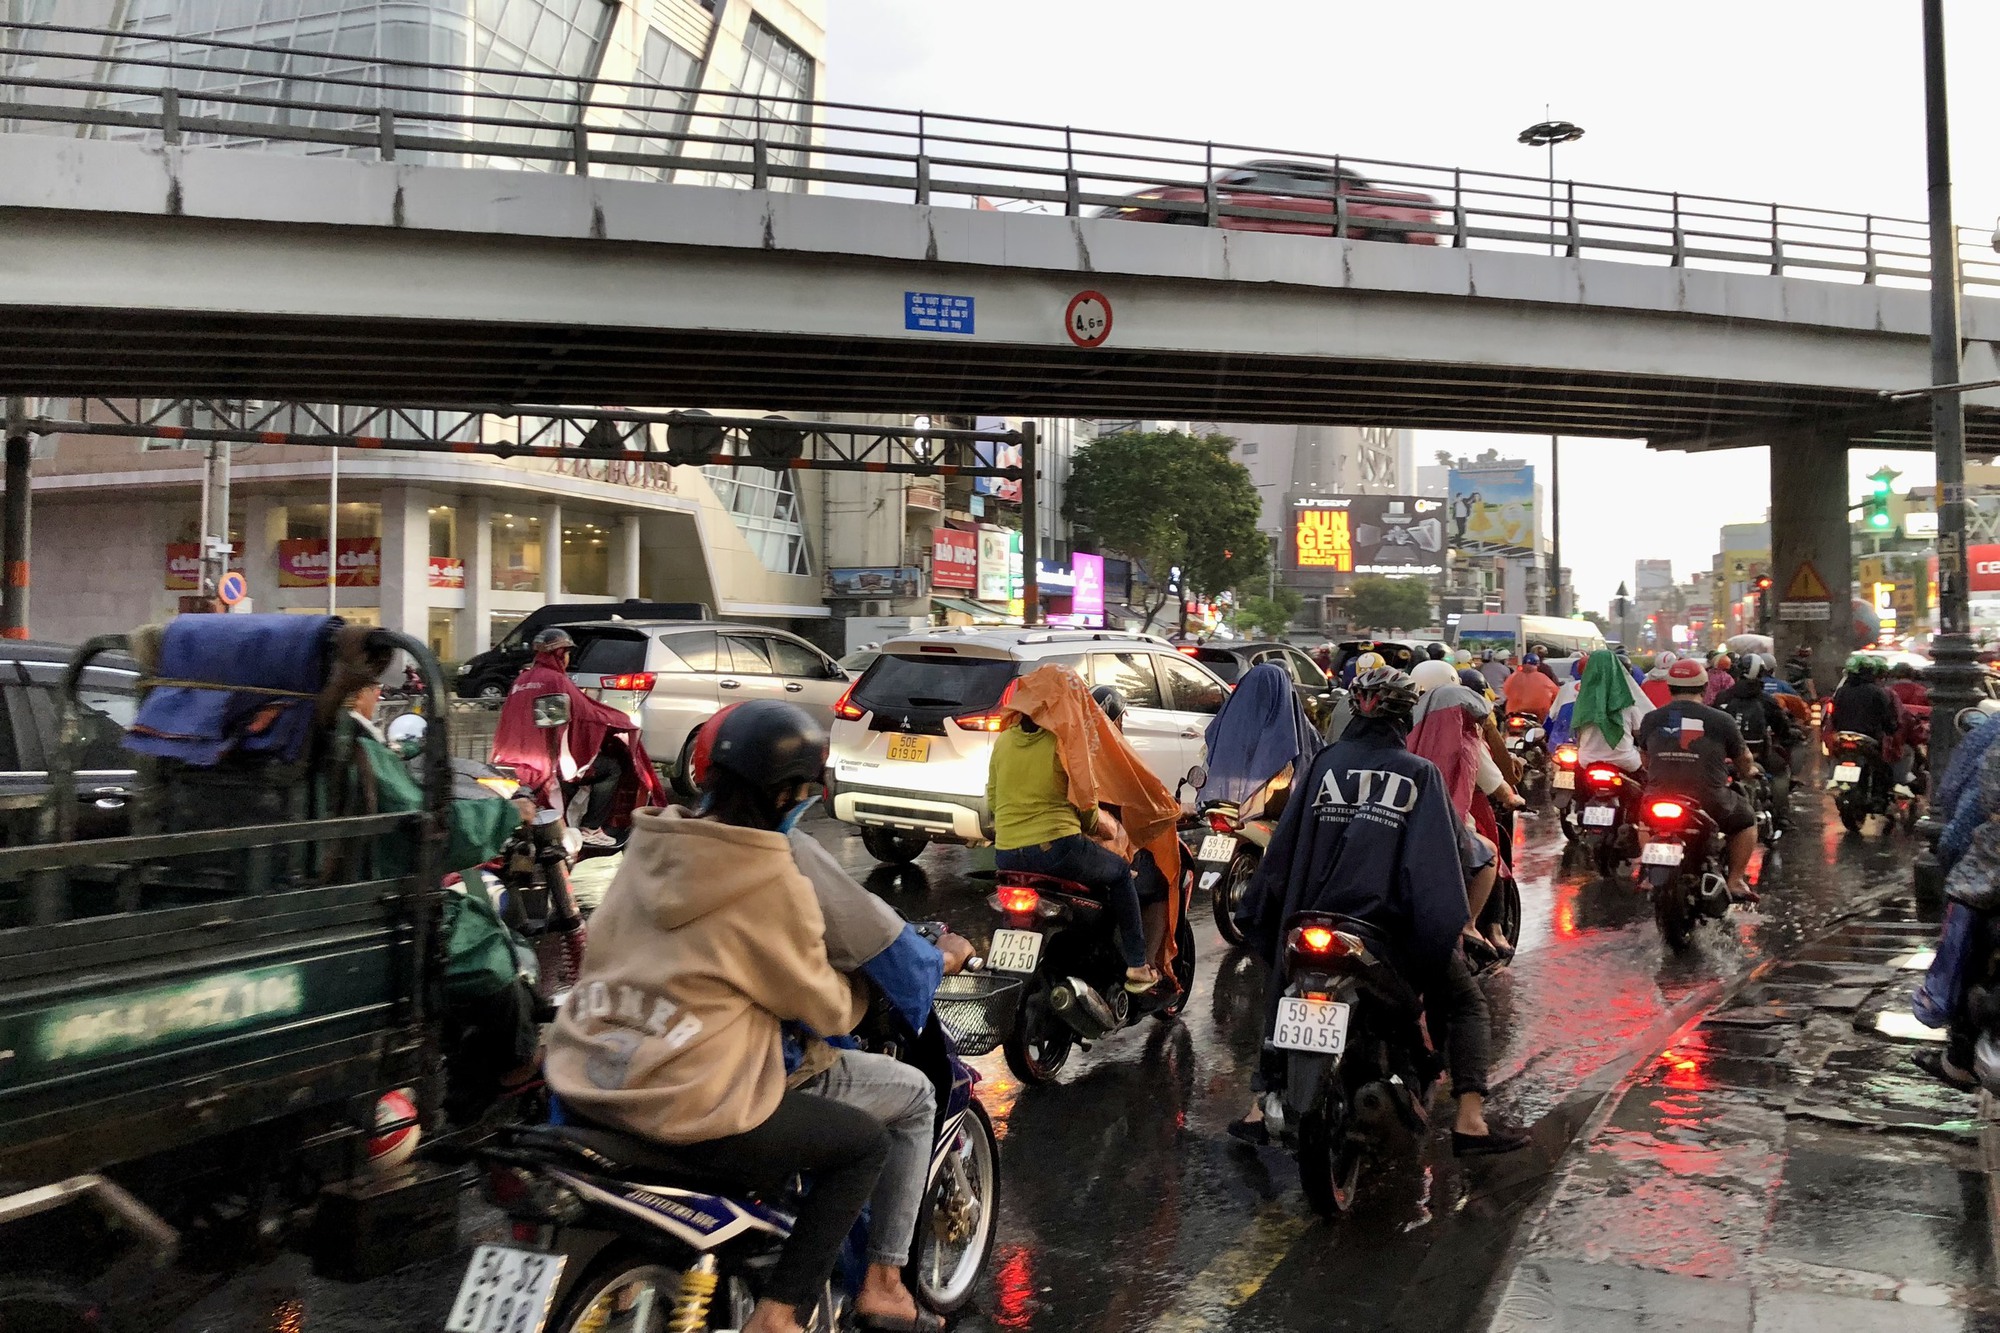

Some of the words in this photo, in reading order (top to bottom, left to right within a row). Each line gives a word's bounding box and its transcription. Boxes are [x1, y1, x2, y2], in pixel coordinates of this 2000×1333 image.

[1297, 510, 1348, 531] JUN
[1297, 529, 1351, 549] GER
[900, 736, 918, 748] 50E
[891, 747, 923, 760] 019.07
[1311, 768, 1418, 813] ATD
[1207, 838, 1231, 849] 59-E1
[1000, 933, 1034, 951] 77-C1
[991, 950, 1034, 970] 487.50
[1288, 1002, 1338, 1027] 59-S2
[1279, 1024, 1342, 1049] 630.55
